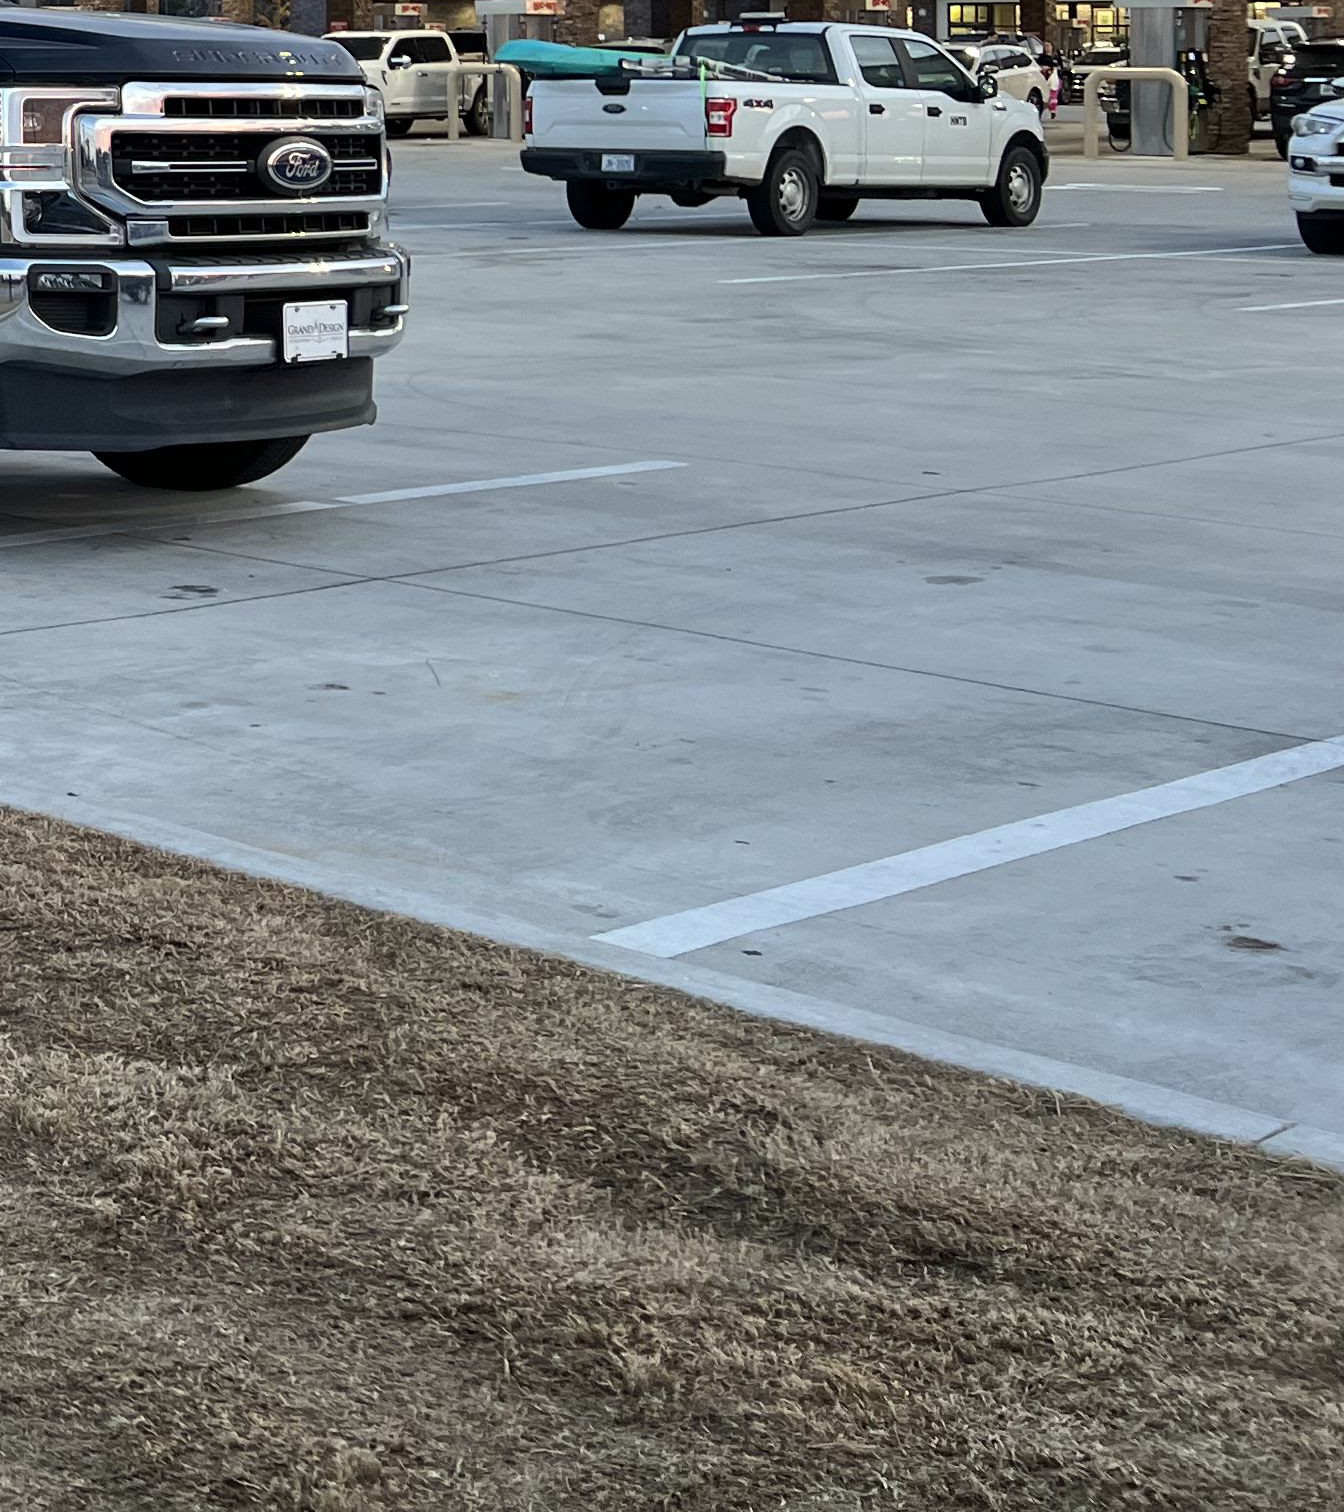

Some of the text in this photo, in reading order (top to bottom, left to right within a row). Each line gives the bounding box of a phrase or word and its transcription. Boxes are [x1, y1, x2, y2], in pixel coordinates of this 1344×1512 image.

[286, 152, 319, 177] Ford
[288, 322, 344, 336] GRAND DESIGN
